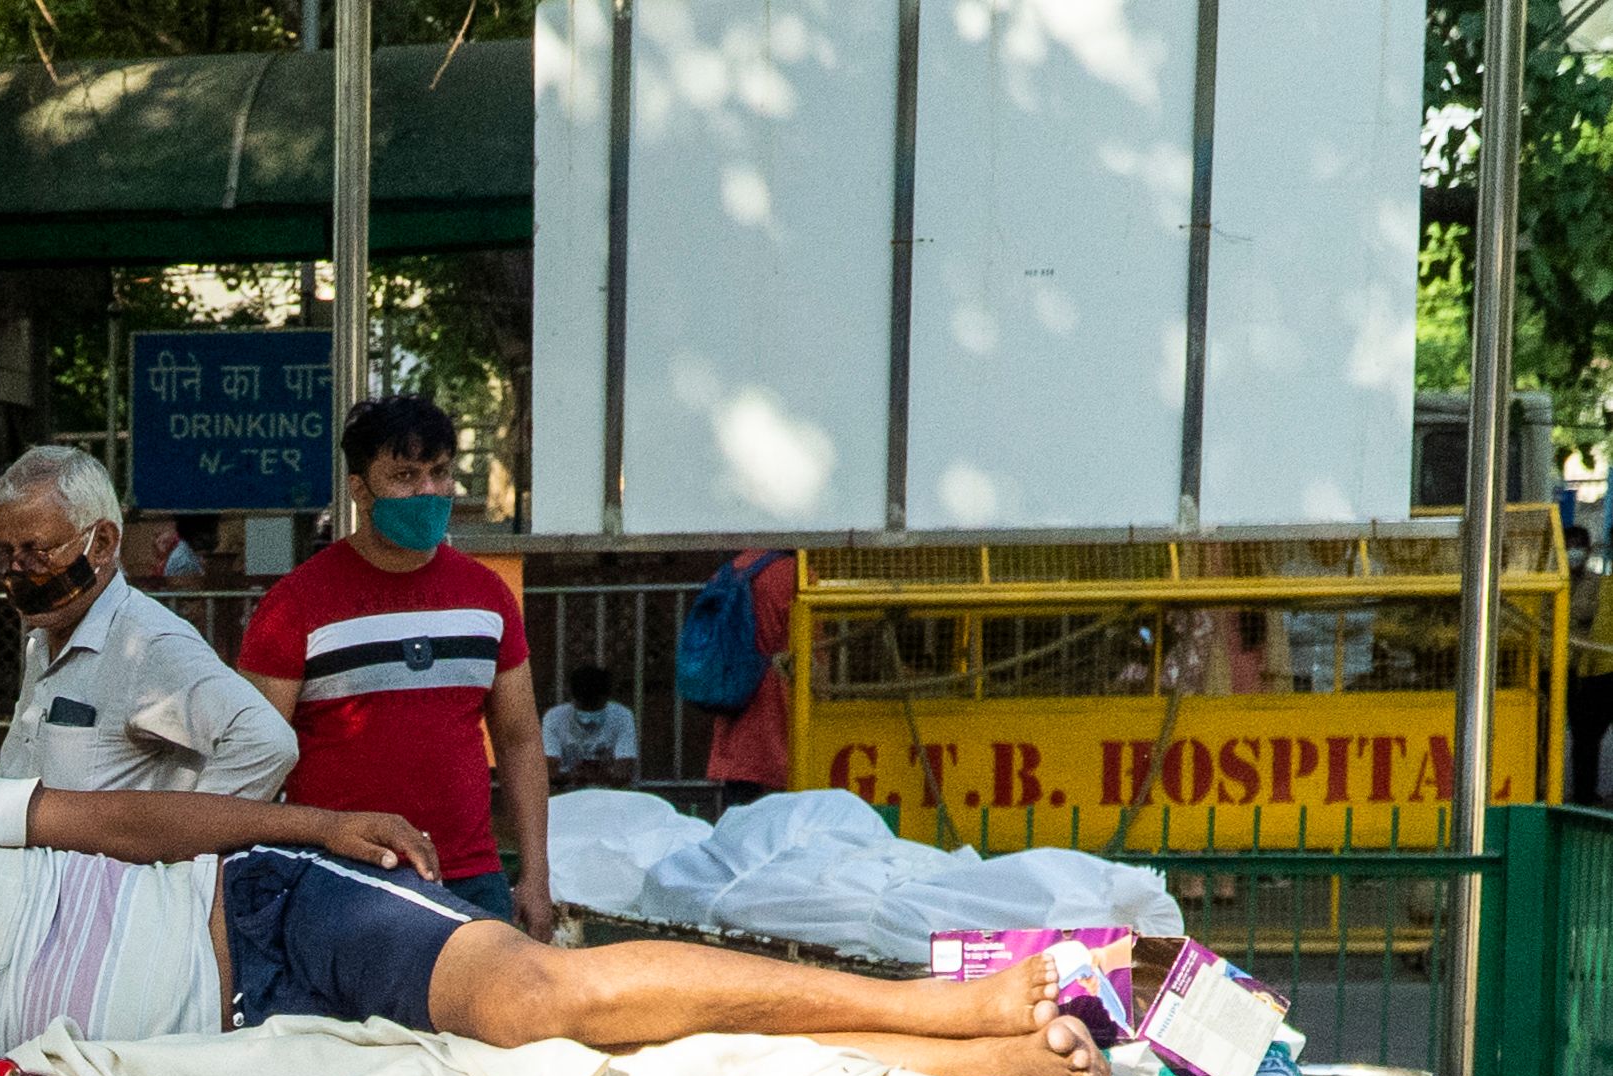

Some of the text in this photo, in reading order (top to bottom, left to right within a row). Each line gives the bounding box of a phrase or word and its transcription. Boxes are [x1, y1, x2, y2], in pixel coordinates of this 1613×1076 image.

[147, 350, 202, 402] पीने
[221, 364, 261, 400] का
[169, 412, 324, 440] DRINKING
[828, 735, 1512, 808] G.T.B. HOSPITA
[1155, 1000, 1182, 1039] PHILIPS
